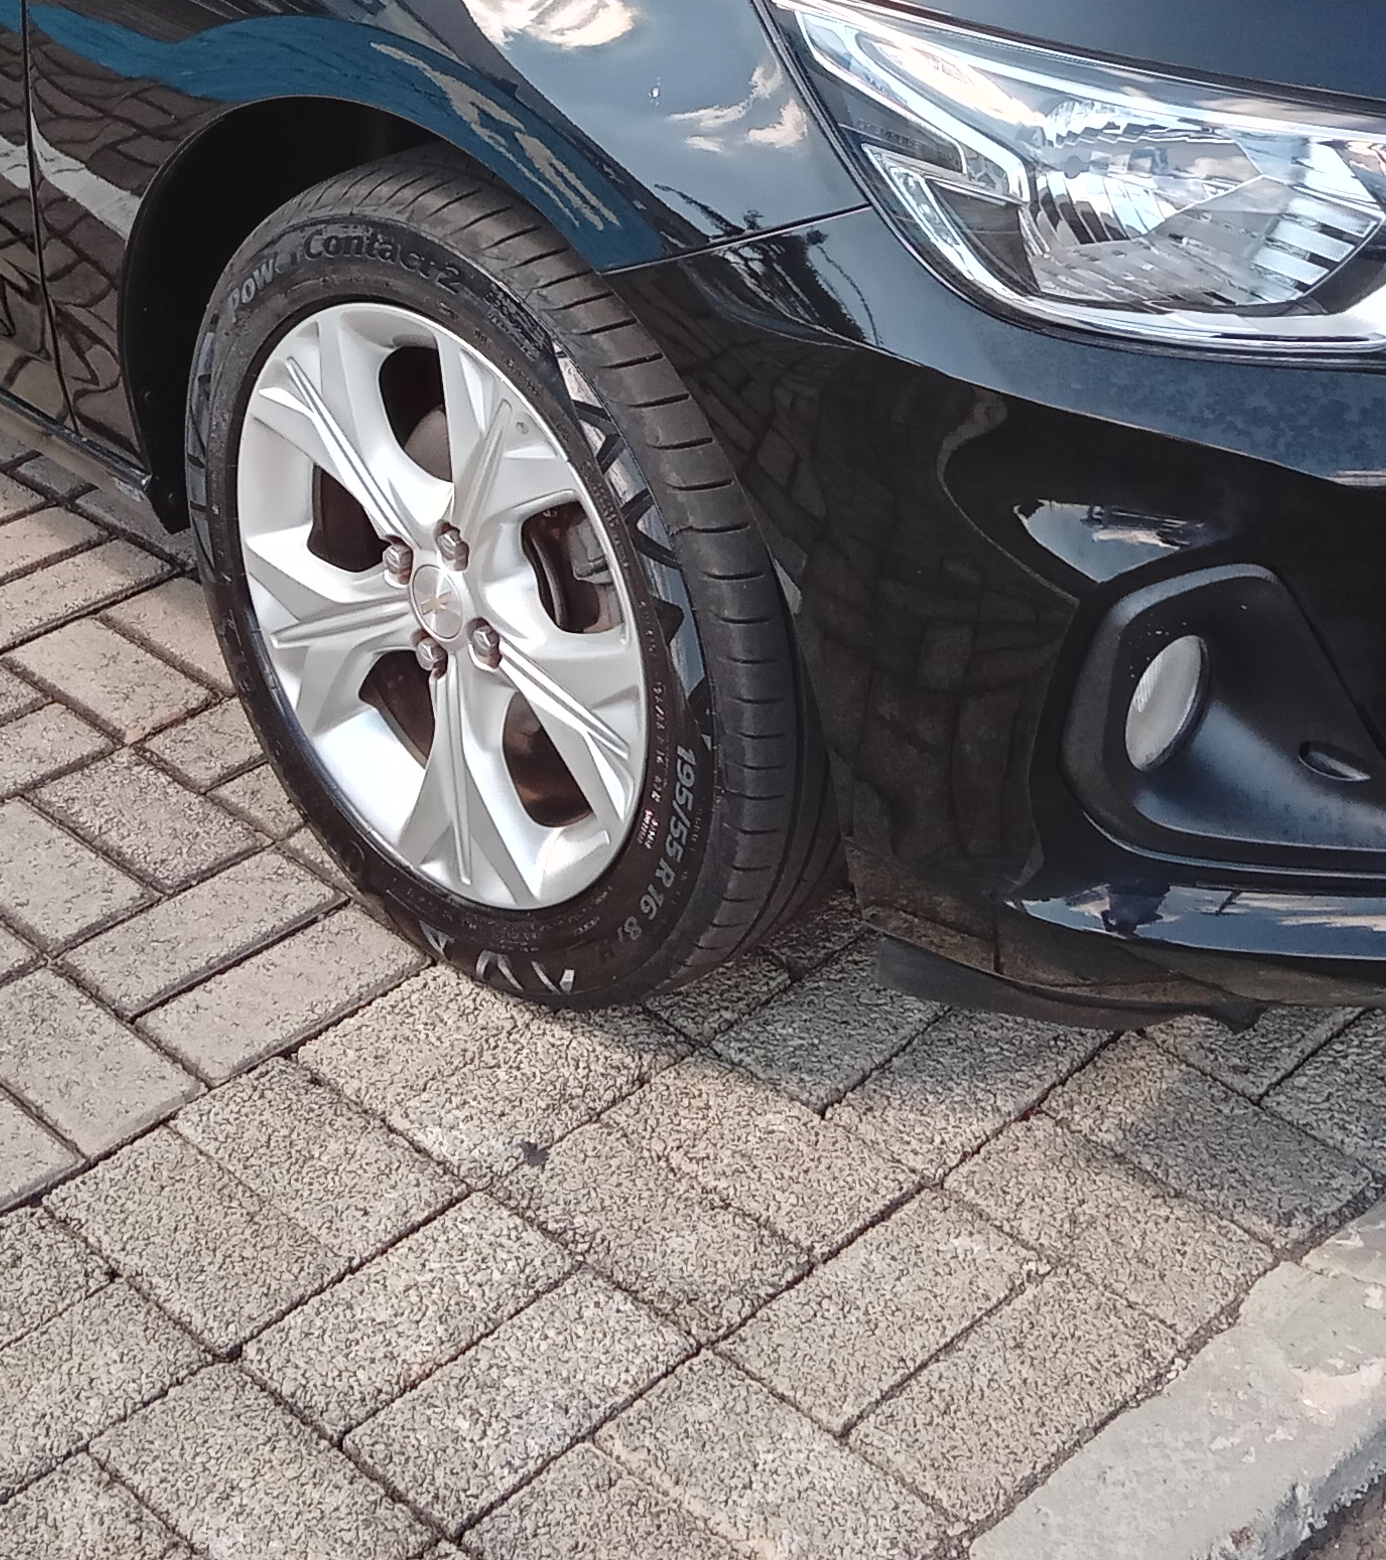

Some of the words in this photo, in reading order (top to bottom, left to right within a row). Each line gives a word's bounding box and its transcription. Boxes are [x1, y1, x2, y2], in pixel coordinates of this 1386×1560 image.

[437, 266, 463, 295] 2
[665, 745, 697, 863] 195/55
[655, 857, 675, 888] R
[640, 884, 664, 920] 16
